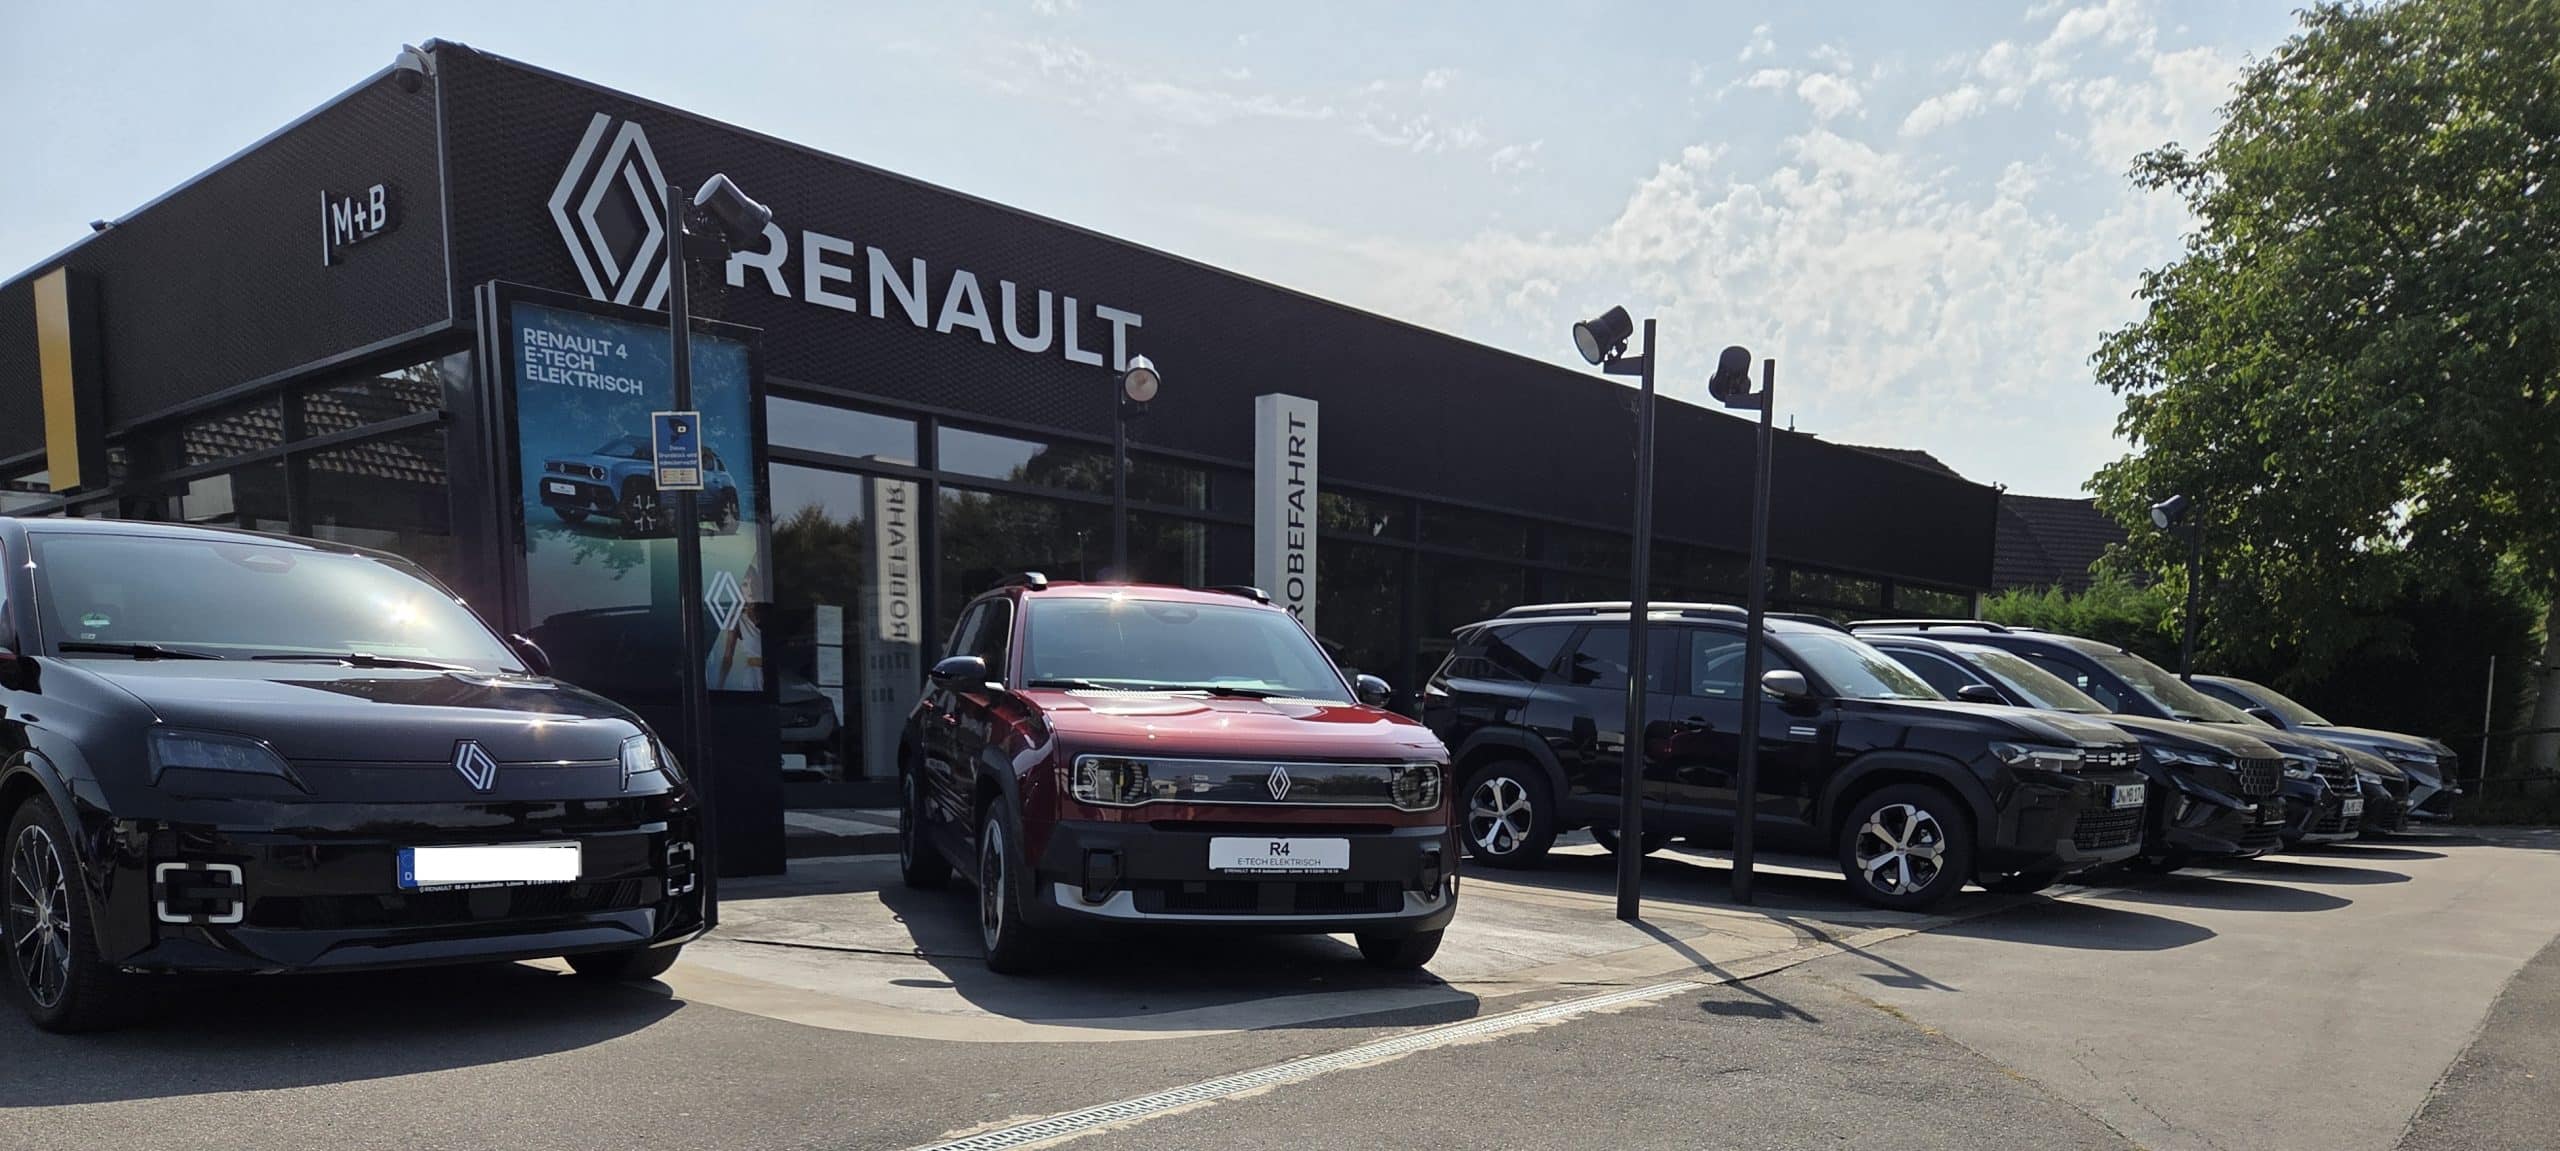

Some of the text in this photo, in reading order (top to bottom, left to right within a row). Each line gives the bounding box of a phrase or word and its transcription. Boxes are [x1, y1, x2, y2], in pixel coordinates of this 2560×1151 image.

[726, 222, 1142, 372] RENAULT
[523, 327, 628, 359] RENAULT 4
[524, 345, 595, 372] E-TECH
[525, 363, 643, 396] ELEKTRISCH
[1287, 411, 1306, 623] ROBEFAHRT
[1238, 857, 1321, 866] E-TECH ELEKTRISCH
[1269, 842, 1290, 856] R4
[404, 871, 413, 881] D
[424, 884, 452, 893] RENAULT
